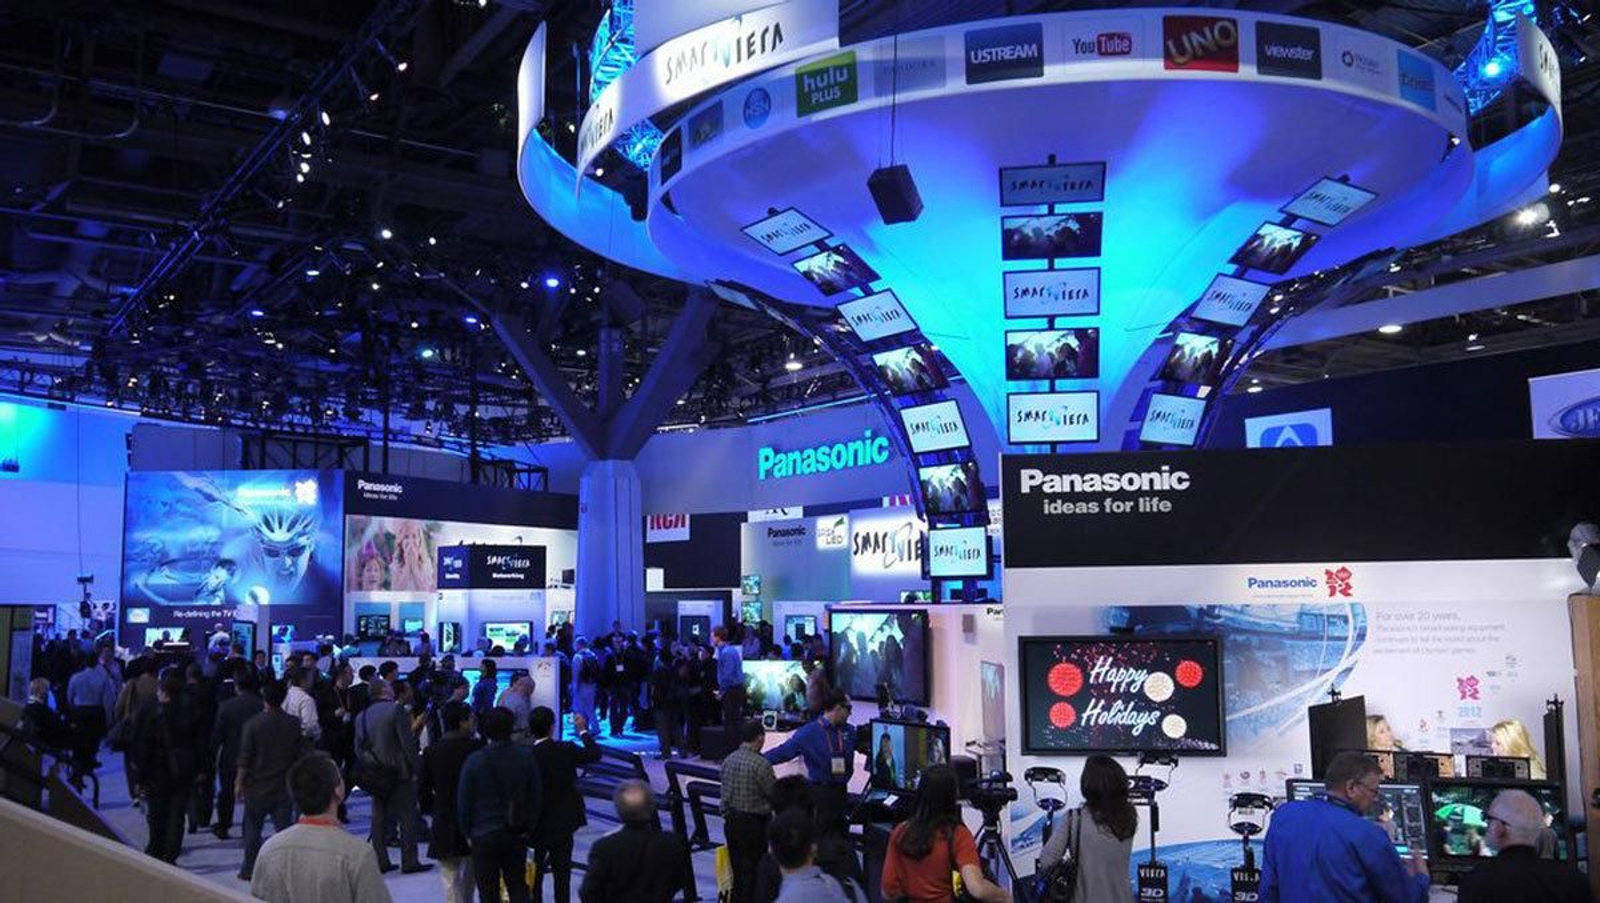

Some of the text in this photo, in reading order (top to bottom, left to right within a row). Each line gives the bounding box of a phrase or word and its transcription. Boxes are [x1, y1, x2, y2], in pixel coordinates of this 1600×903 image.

[1166, 20, 1237, 64] UNO
[970, 43, 1039, 64] USTREAM
[1265, 44, 1316, 61] viewster
[803, 65, 849, 93] hulu
[811, 87, 841, 104] PLUS
[758, 428, 890, 481] Panasonic
[357, 479, 403, 493] Panasonic
[1020, 466, 1191, 494] Panasonic
[1043, 497, 1173, 515] ideas for life
[768, 525, 807, 539] Panasonic
[1248, 576, 1318, 590] Panasonic
[1376, 611, 1392, 620] For
[1418, 611, 1430, 620] 20
[1090, 655, 1149, 694] Happy
[1081, 698, 1161, 736] Holidays
